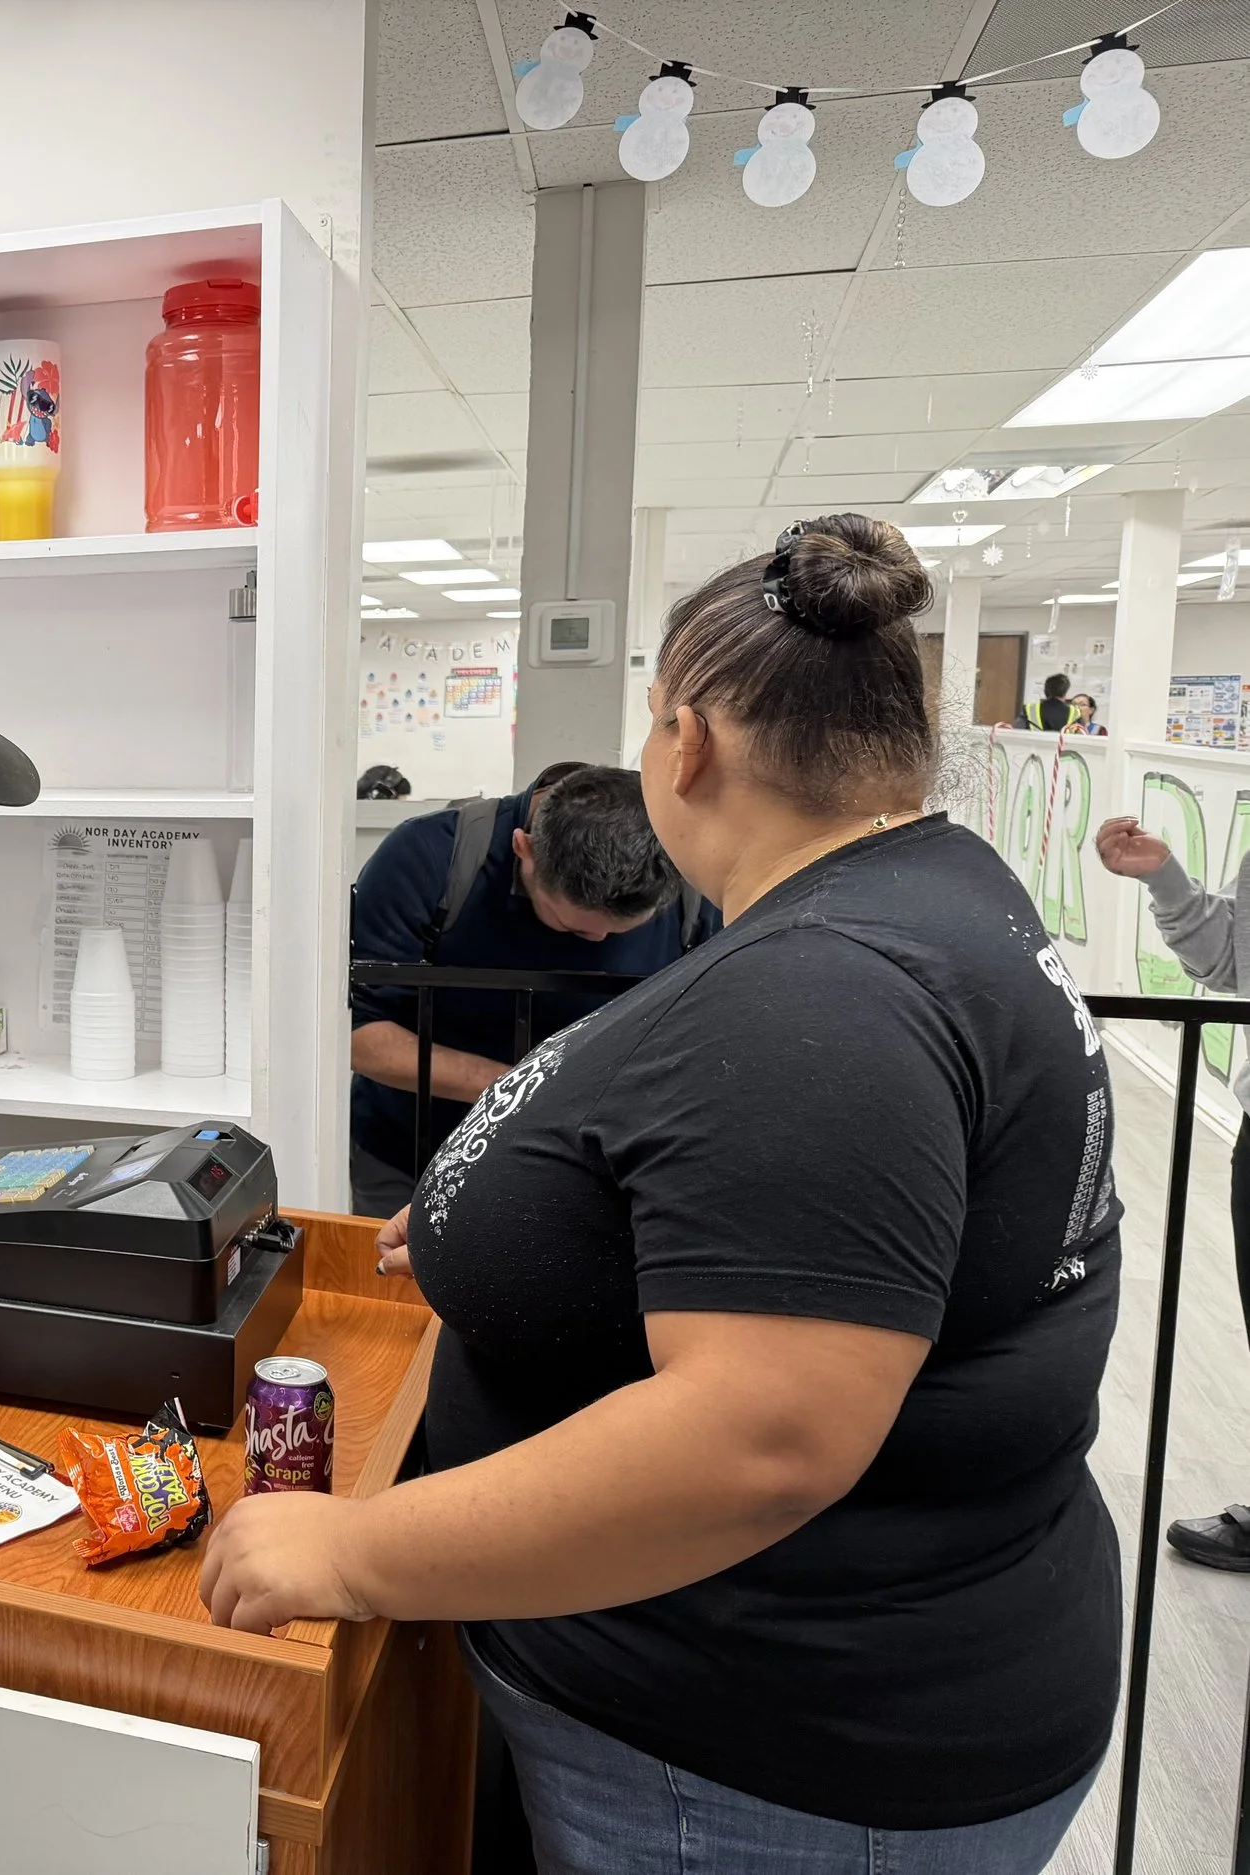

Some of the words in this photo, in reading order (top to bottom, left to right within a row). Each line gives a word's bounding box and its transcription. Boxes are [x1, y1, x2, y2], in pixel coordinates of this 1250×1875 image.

[85, 827, 109, 836] NOR
[114, 829, 137, 838] DAY
[141, 830, 200, 840] ACADEMY
[264, 1463, 311, 1483] Grape
[4, 1472, 61, 1503] ACADEMY
